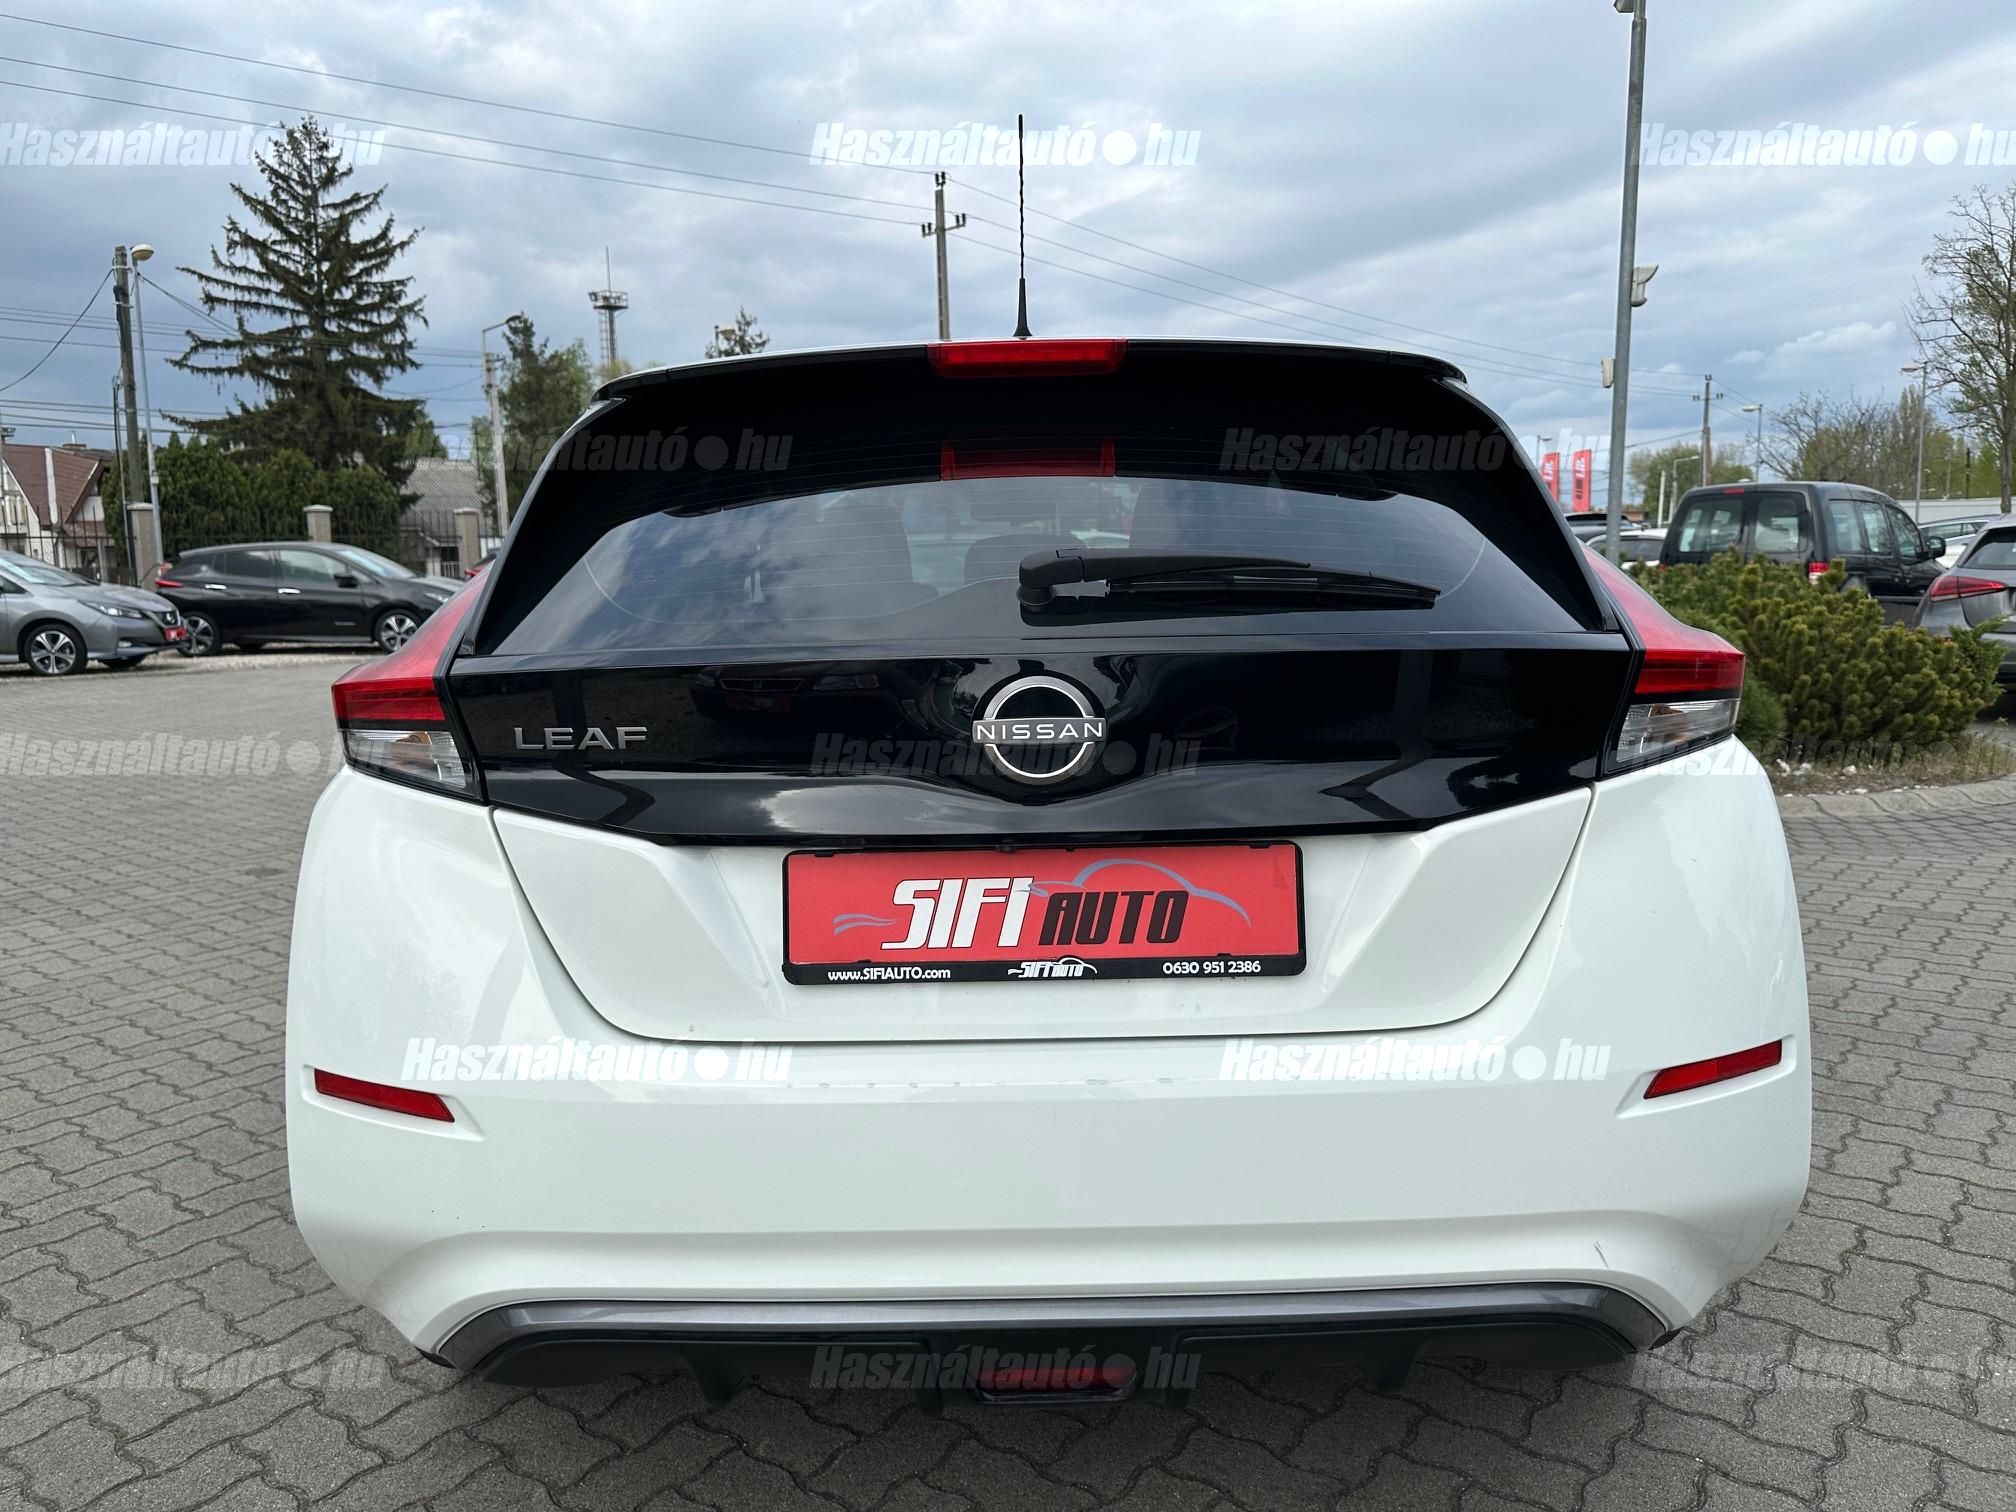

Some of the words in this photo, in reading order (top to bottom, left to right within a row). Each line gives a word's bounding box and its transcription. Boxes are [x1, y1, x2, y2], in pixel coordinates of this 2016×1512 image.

[514, 726, 648, 750] LEAF
[976, 721, 1103, 740] NISSAN
[880, 876, 1035, 950] SIFI
[1038, 889, 1190, 947] AUTO
[827, 966, 951, 981] www.SIFIAUTO.com
[1162, 961, 1200, 975] 0630
[1202, 961, 1225, 974] 951
[1227, 960, 1262, 974] 2386
